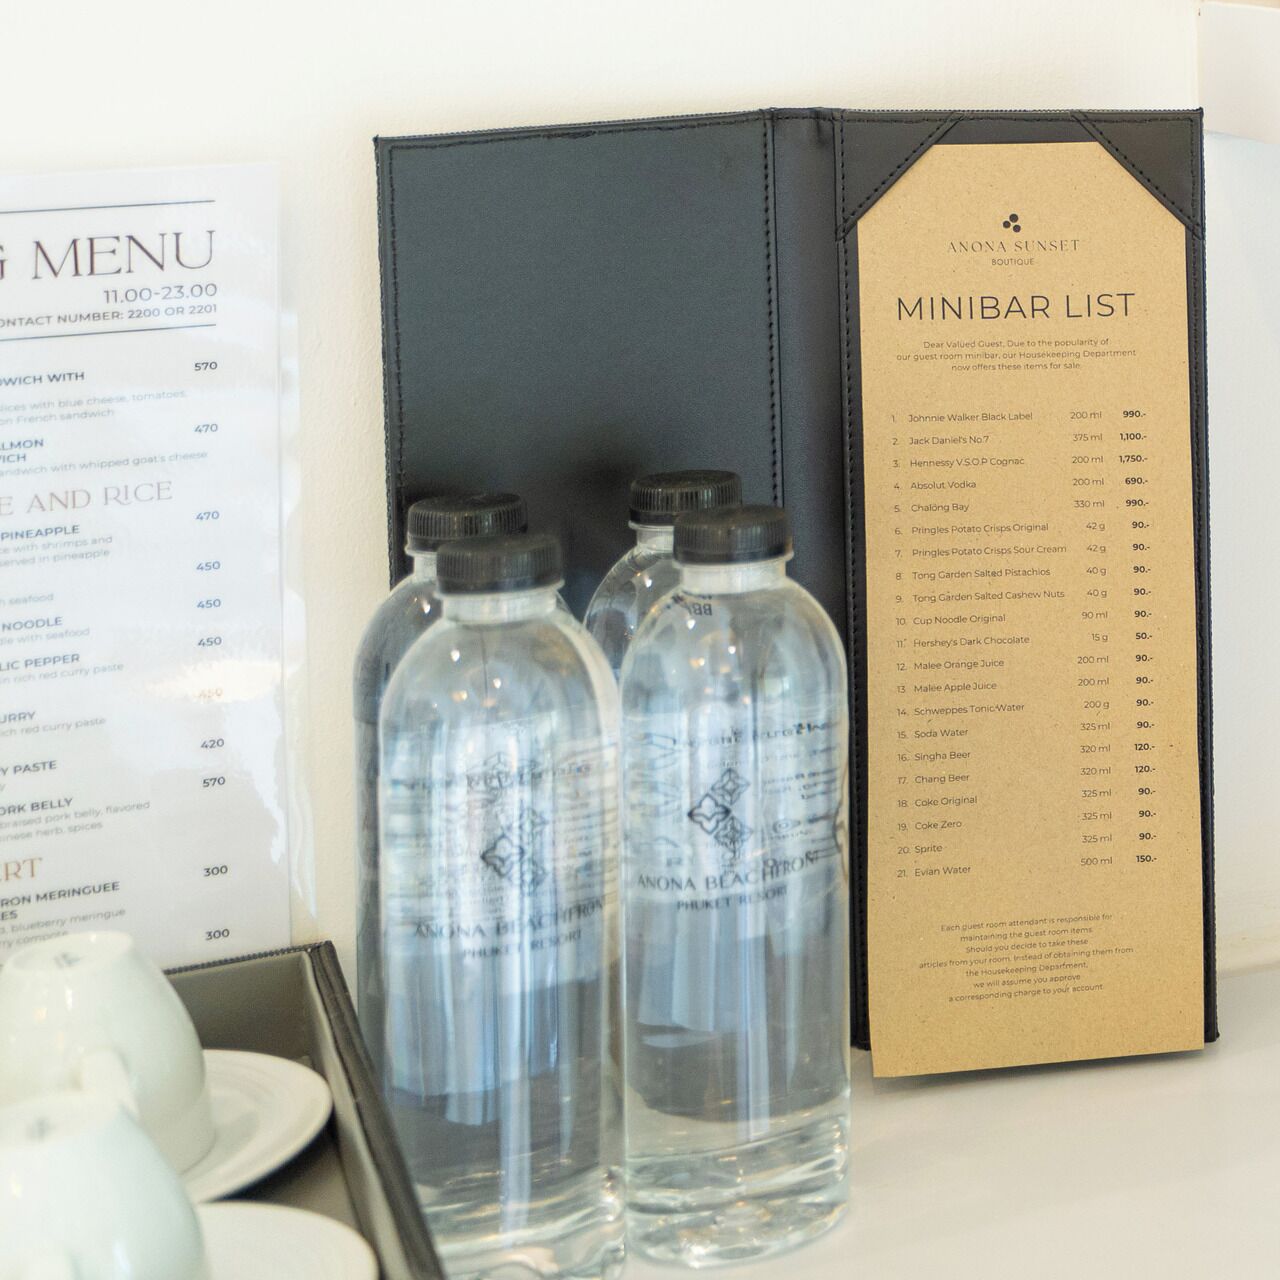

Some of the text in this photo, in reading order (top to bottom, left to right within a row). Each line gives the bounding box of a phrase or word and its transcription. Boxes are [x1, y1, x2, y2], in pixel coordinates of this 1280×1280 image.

[948, 240, 1080, 253] ANONA SUNSET
[32, 230, 215, 280] MENU
[991, 258, 1034, 266] BOUTIQUE
[103, 283, 217, 304] 11.00-23.00
[897, 293, 1136, 320] MINIBAR LIST
[57, 311, 123, 323] NUMBER:
[127, 308, 160, 319] 2200
[164, 306, 185, 316] OR
[189, 304, 217, 315] 2201
[923, 341, 944, 349] Dear
[945, 340, 977, 349] Valued
[1006, 339, 1025, 348] Due
[1037, 339, 1053, 347] the
[1054, 338, 1098, 348] popularity
[913, 353, 938, 362] guest
[1001, 351, 1017, 359] our
[1018, 350, 1081, 360] Housekeeping
[1082, 350, 1136, 359] Department
[194, 361, 218, 371] 570
[47, 372, 84, 383] WITH
[908, 412, 1033, 423] Johnnie Walker Black Label
[194, 423, 218, 433] 470
[909, 437, 930, 445] Jack
[931, 436, 968, 445] Daniel's
[910, 459, 955, 469] Hennessy
[988, 457, 1024, 467] Cognac
[910, 480, 977, 490] Absolut Vodka
[27, 490, 91, 513] AND
[103, 480, 173, 506] RICE
[952, 503, 969, 512] Bay
[196, 510, 220, 521] 470
[0, 525, 79, 541] PINEAPPLE
[912, 523, 1049, 537] Pringles Potato Crisps Original
[912, 544, 1067, 559] Pringles Potato Crisps Sour Cream
[196, 561, 221, 571] 450
[912, 567, 1051, 582] Tong Garden Salted Pistachios
[197, 598, 221, 609] 450
[912, 590, 1065, 606] Tong Garden Salted Cashew Nuts
[2, 616, 62, 632] NOODLE
[913, 614, 1006, 626] Cup Noodle Original
[197, 636, 222, 647] 450
[913, 636, 1030, 648] Hershey's Dark Chocolate
[24, 653, 80, 668] PEPPER
[914, 658, 1004, 670] Malee Orange Juice
[914, 682, 997, 693] Malee Apple Juice
[914, 707, 968, 716] Schweppes
[914, 730, 938, 739] Soda
[200, 738, 225, 749] 420
[914, 751, 971, 762] Singha Beer
[13, 760, 56, 774] PASTE
[203, 776, 226, 788] 570
[914, 774, 970, 784] Chang Beer
[30, 798, 72, 812] BELLY
[914, 795, 977, 807] Coke Original
[915, 820, 962, 831] Coke Zero
[914, 844, 943, 855] Sprite
[204, 865, 228, 877] 300
[915, 866, 971, 877] Evian Water
[639, 874, 697, 892] ANONA
[36, 881, 119, 902] MERINGUEE
[676, 896, 732, 911] PHUKET
[206, 928, 230, 941] 300
[414, 920, 487, 939] ANONA
